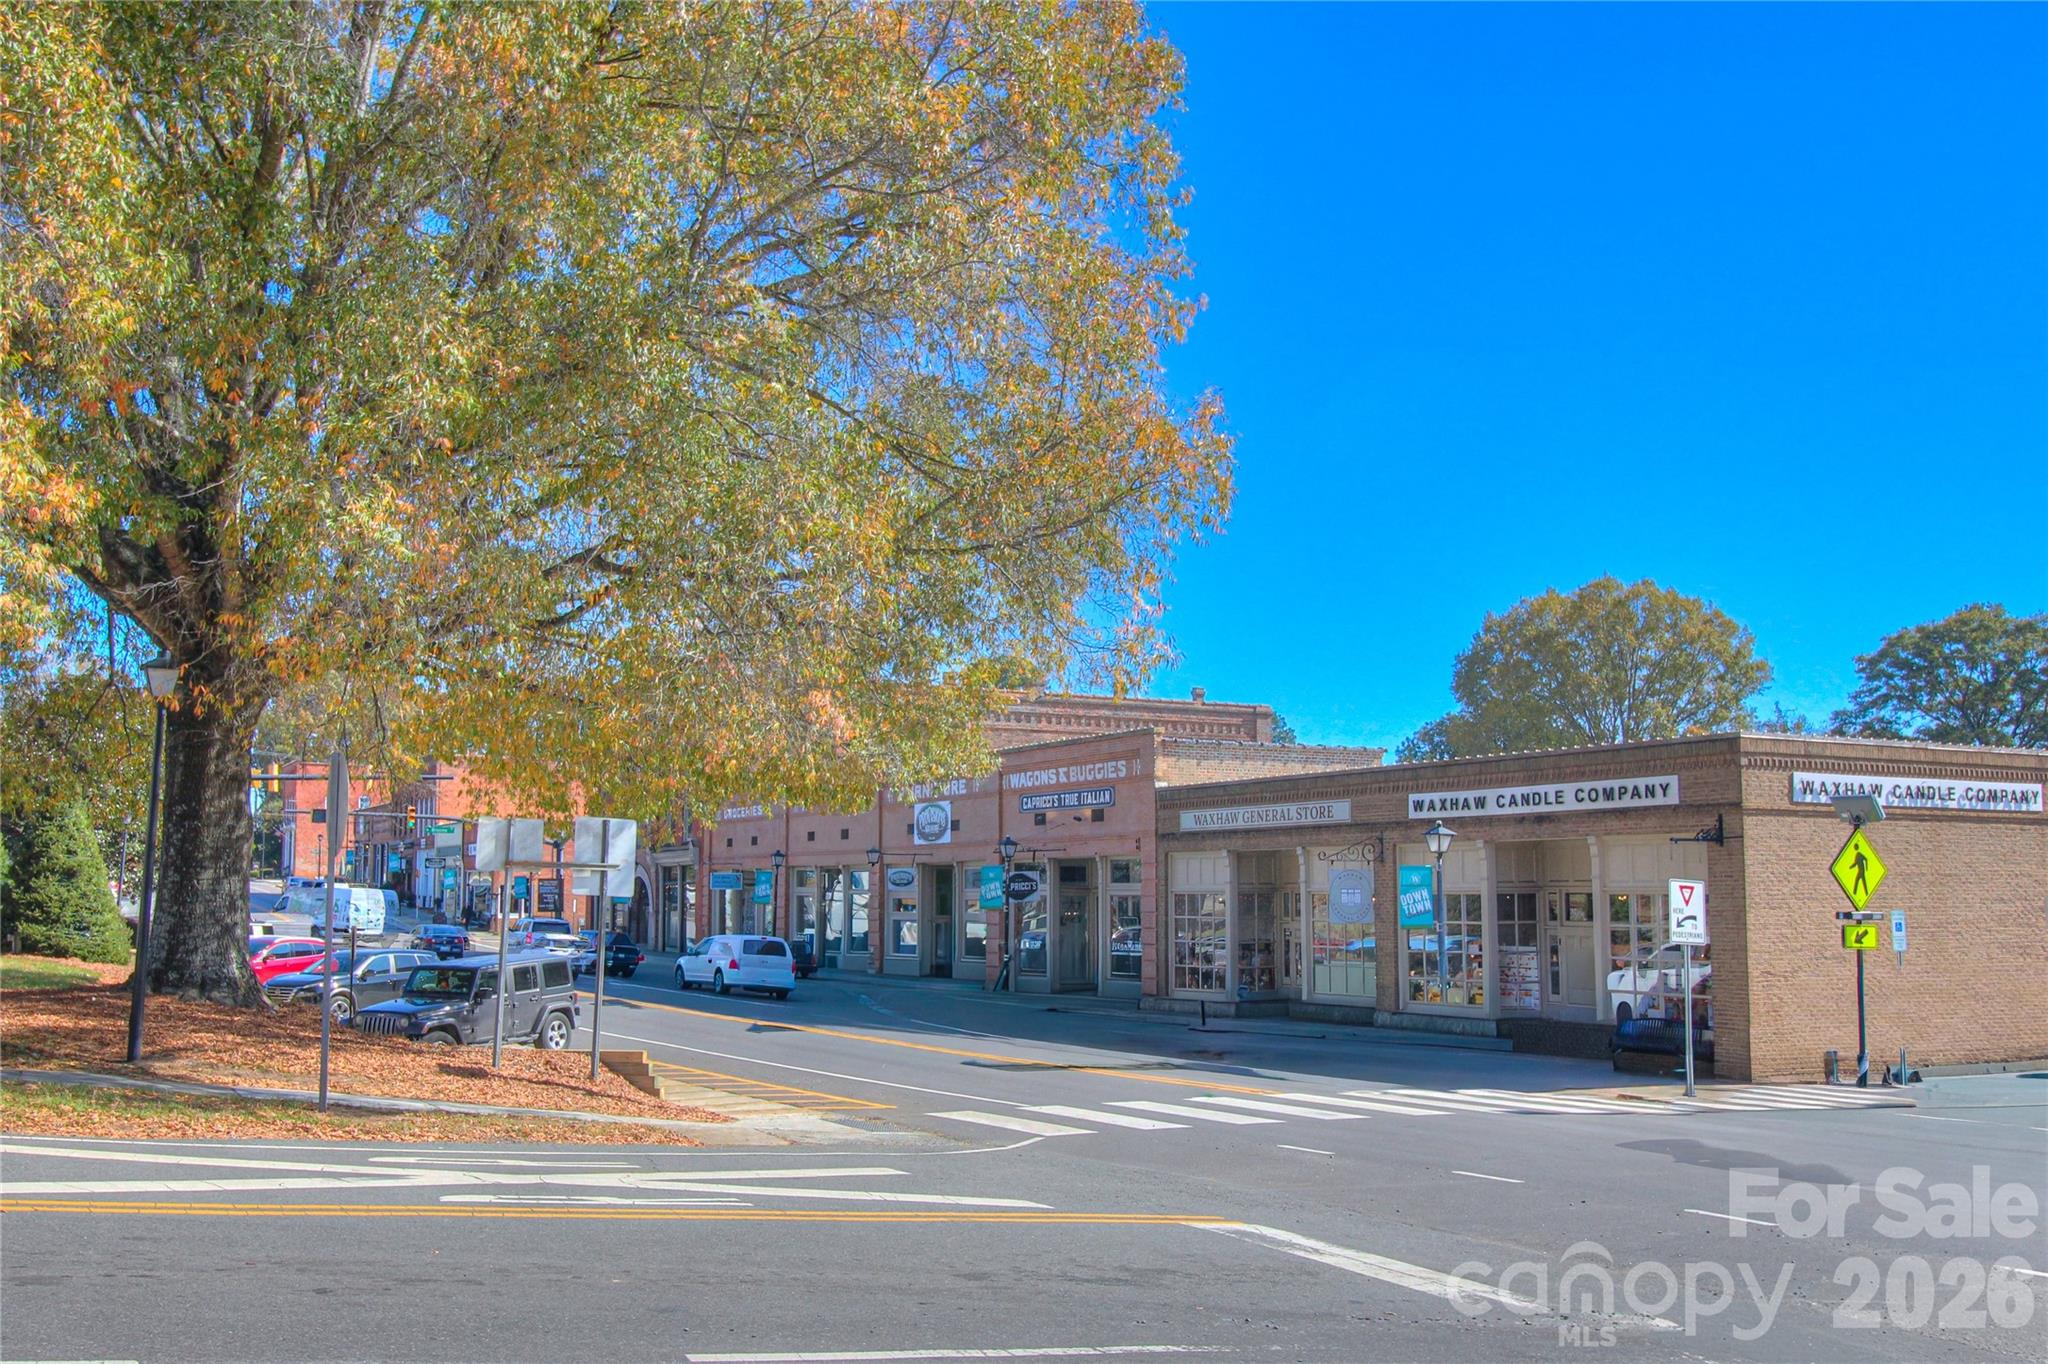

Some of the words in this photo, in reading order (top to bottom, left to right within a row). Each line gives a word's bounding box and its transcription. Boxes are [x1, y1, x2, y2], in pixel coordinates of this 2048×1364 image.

[1010, 768, 1057, 789] WAGONS
[1058, 767, 1068, 783] &
[1069, 760, 1127, 782] BUGGIES
[1022, 795, 1059, 810] CAPRICCI'S
[1060, 792, 1079, 807] TRUE
[1080, 790, 1111, 805] ITALIAN
[1412, 796, 1487, 813] WAXHAW
[1496, 790, 1565, 809] CANDLE
[1574, 782, 1672, 803] COMPANY
[1800, 780, 1883, 796] WAXHAW
[1892, 784, 1956, 801] CANDLE
[1965, 787, 2040, 805] COMPANY
[1193, 812, 1241, 826] WAXHAW
[1242, 807, 1294, 824] GENERAL
[1295, 805, 1334, 821] STORE
[1010, 882, 1037, 891] PRICCI'S
[1400, 887, 1429, 906] DOWN
[1402, 899, 1432, 917] TOWN
